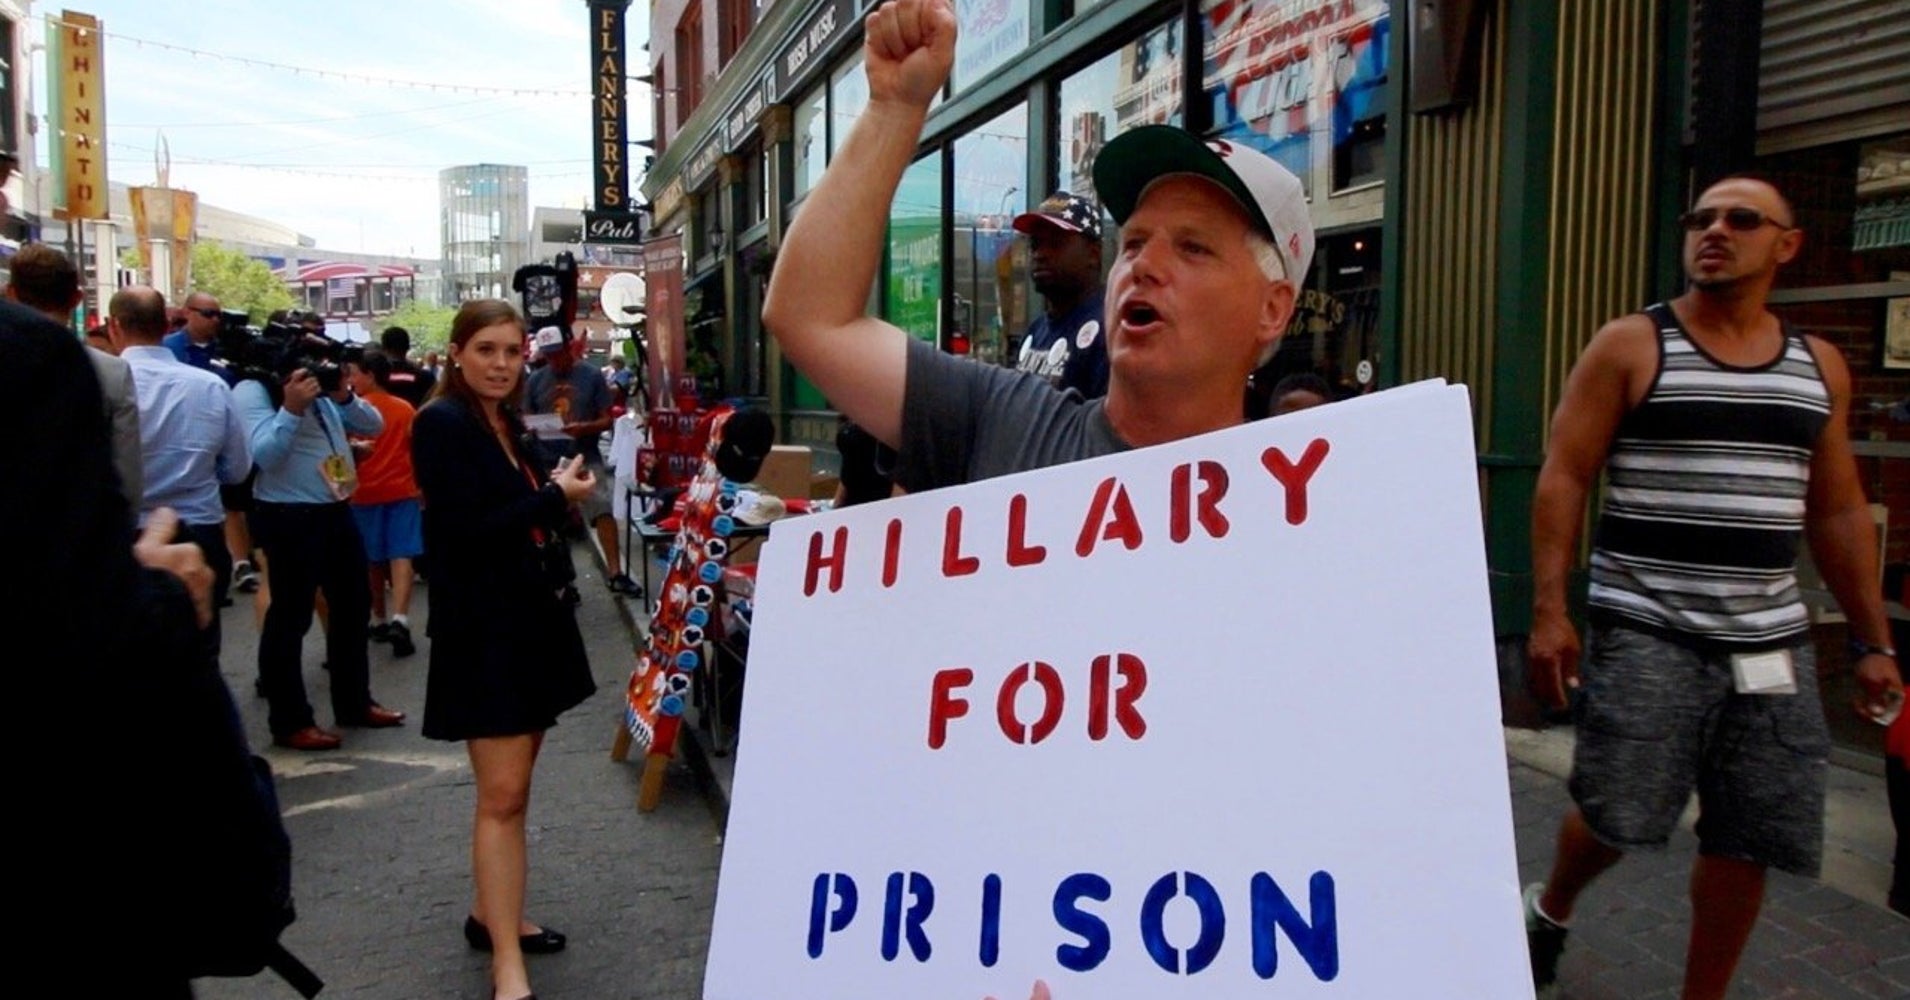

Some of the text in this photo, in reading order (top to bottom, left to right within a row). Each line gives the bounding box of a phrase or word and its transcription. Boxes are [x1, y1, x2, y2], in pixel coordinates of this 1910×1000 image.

[787, 5, 836, 76] IRISH MUSIC
[589, 219, 635, 240] Pub
[803, 438, 1329, 596] HILLARY
[927, 654, 1147, 749] FOR
[807, 869, 1340, 982] PRISON
